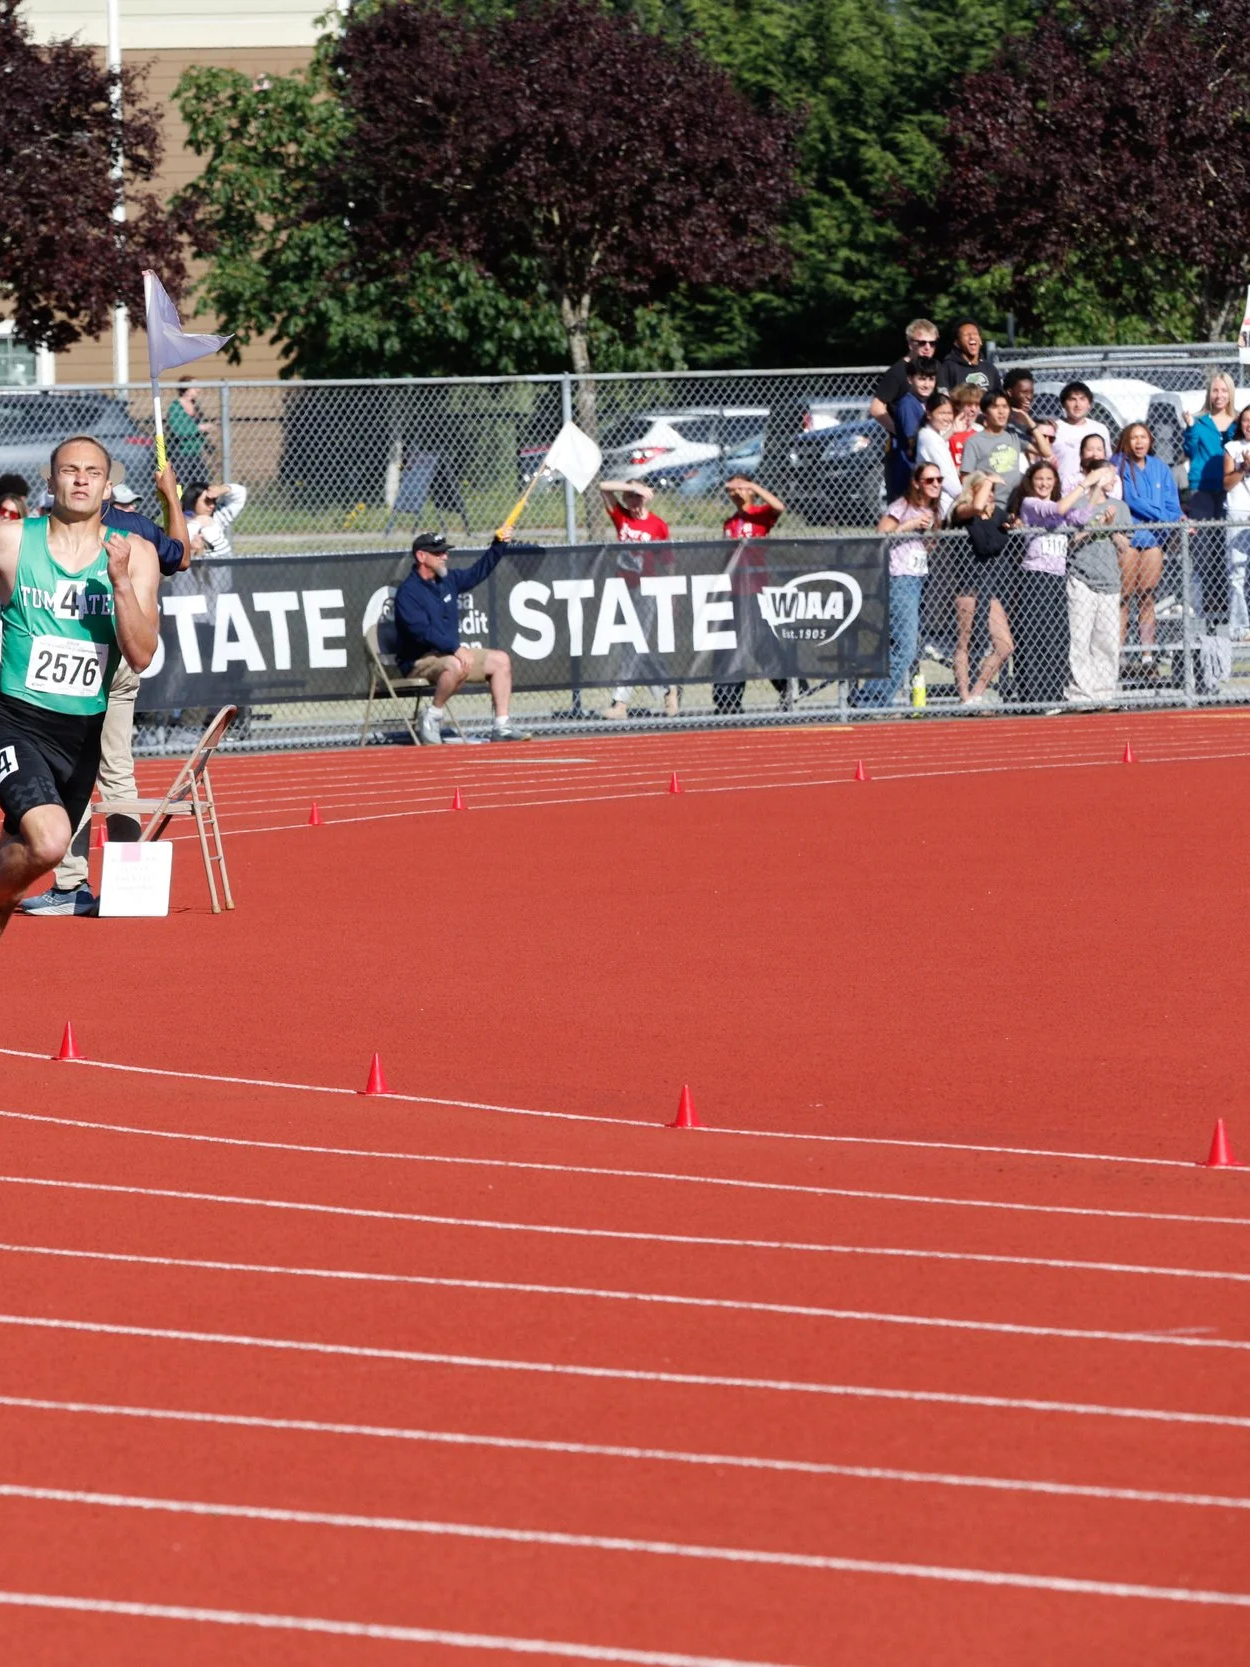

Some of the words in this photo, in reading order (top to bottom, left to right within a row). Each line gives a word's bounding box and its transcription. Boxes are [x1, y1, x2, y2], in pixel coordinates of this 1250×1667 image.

[21, 585, 114, 616] TUMTE
[60, 584, 79, 616] 4
[508, 574, 737, 660] STATE
[770, 592, 844, 619] WIAA
[138, 589, 348, 678] TATE
[35, 650, 99, 686] 2576
